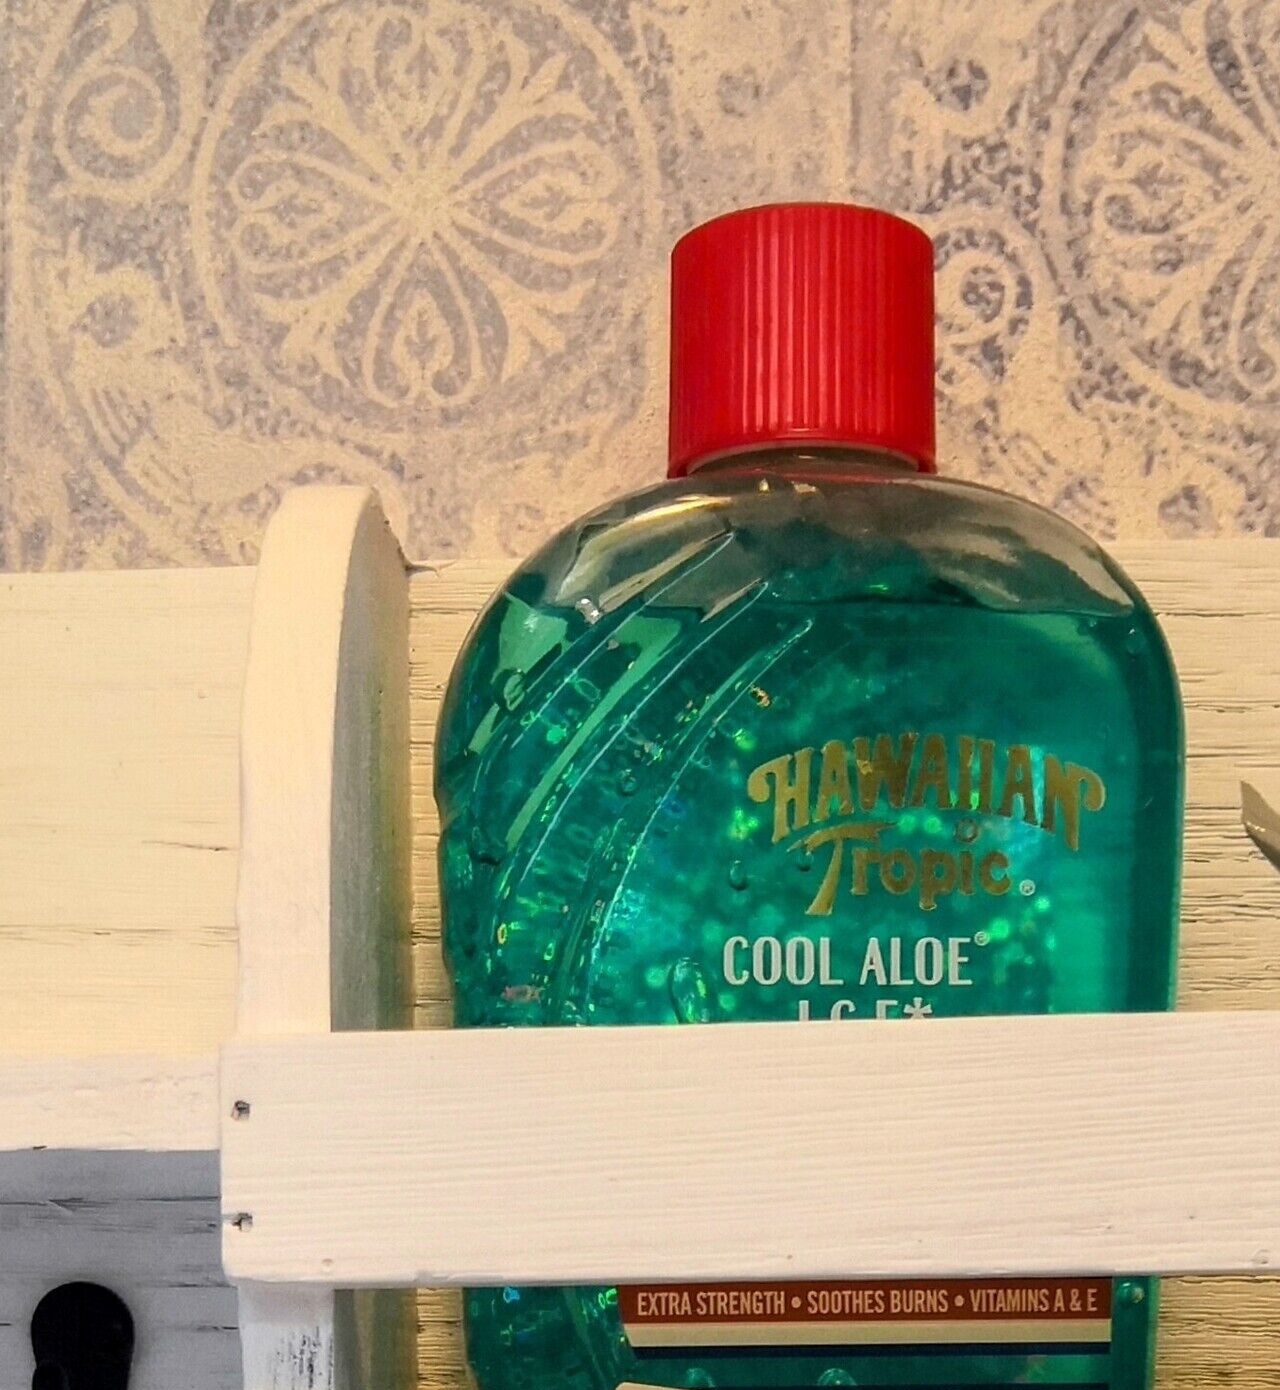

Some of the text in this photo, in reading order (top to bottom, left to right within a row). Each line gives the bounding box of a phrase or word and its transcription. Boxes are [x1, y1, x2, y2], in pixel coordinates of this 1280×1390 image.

[747, 731, 1106, 851] HAWAIIAN
[787, 821, 1011, 915] Tropic
[723, 936, 973, 986] COOL ALOE
[637, 1288, 1099, 1316] EXTRA STRENGTH SOOTHES BURNS VITAMINS A & E
